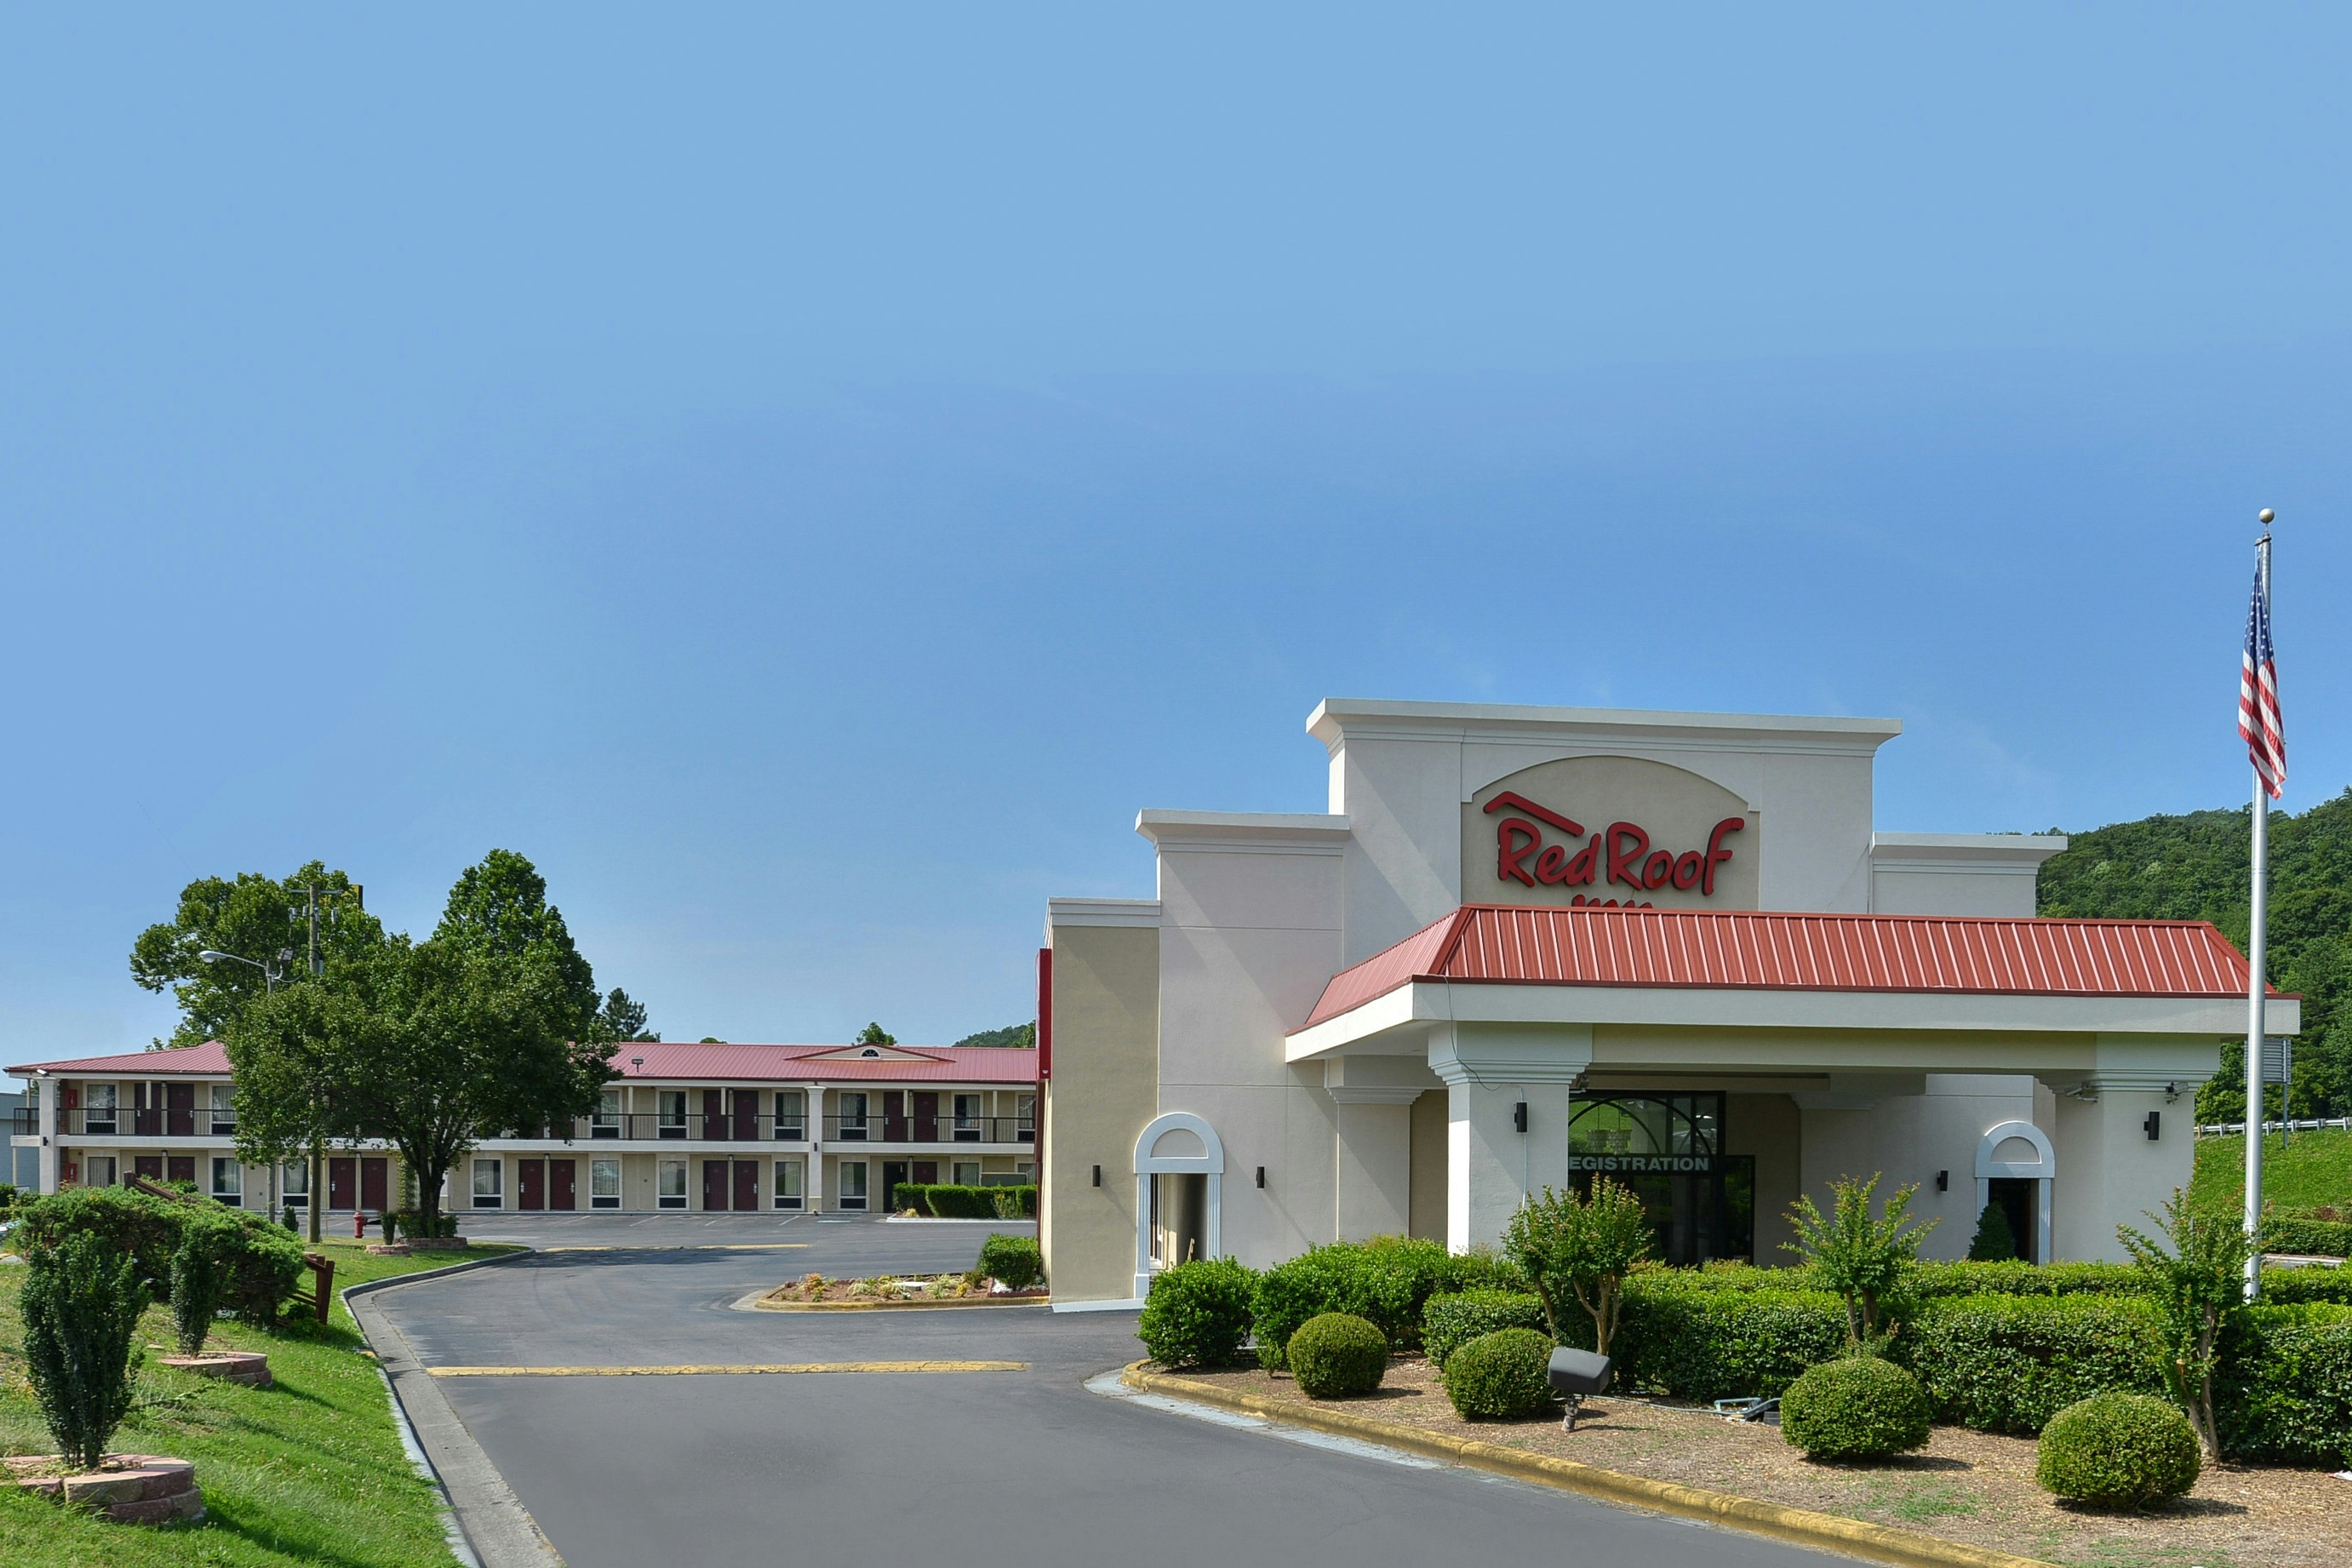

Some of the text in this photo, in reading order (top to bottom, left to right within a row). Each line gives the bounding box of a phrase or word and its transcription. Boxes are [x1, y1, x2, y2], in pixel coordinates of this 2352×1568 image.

[1497, 817, 1744, 896] Red Roof
[1568, 1156, 1709, 1170] EGISTRATION
